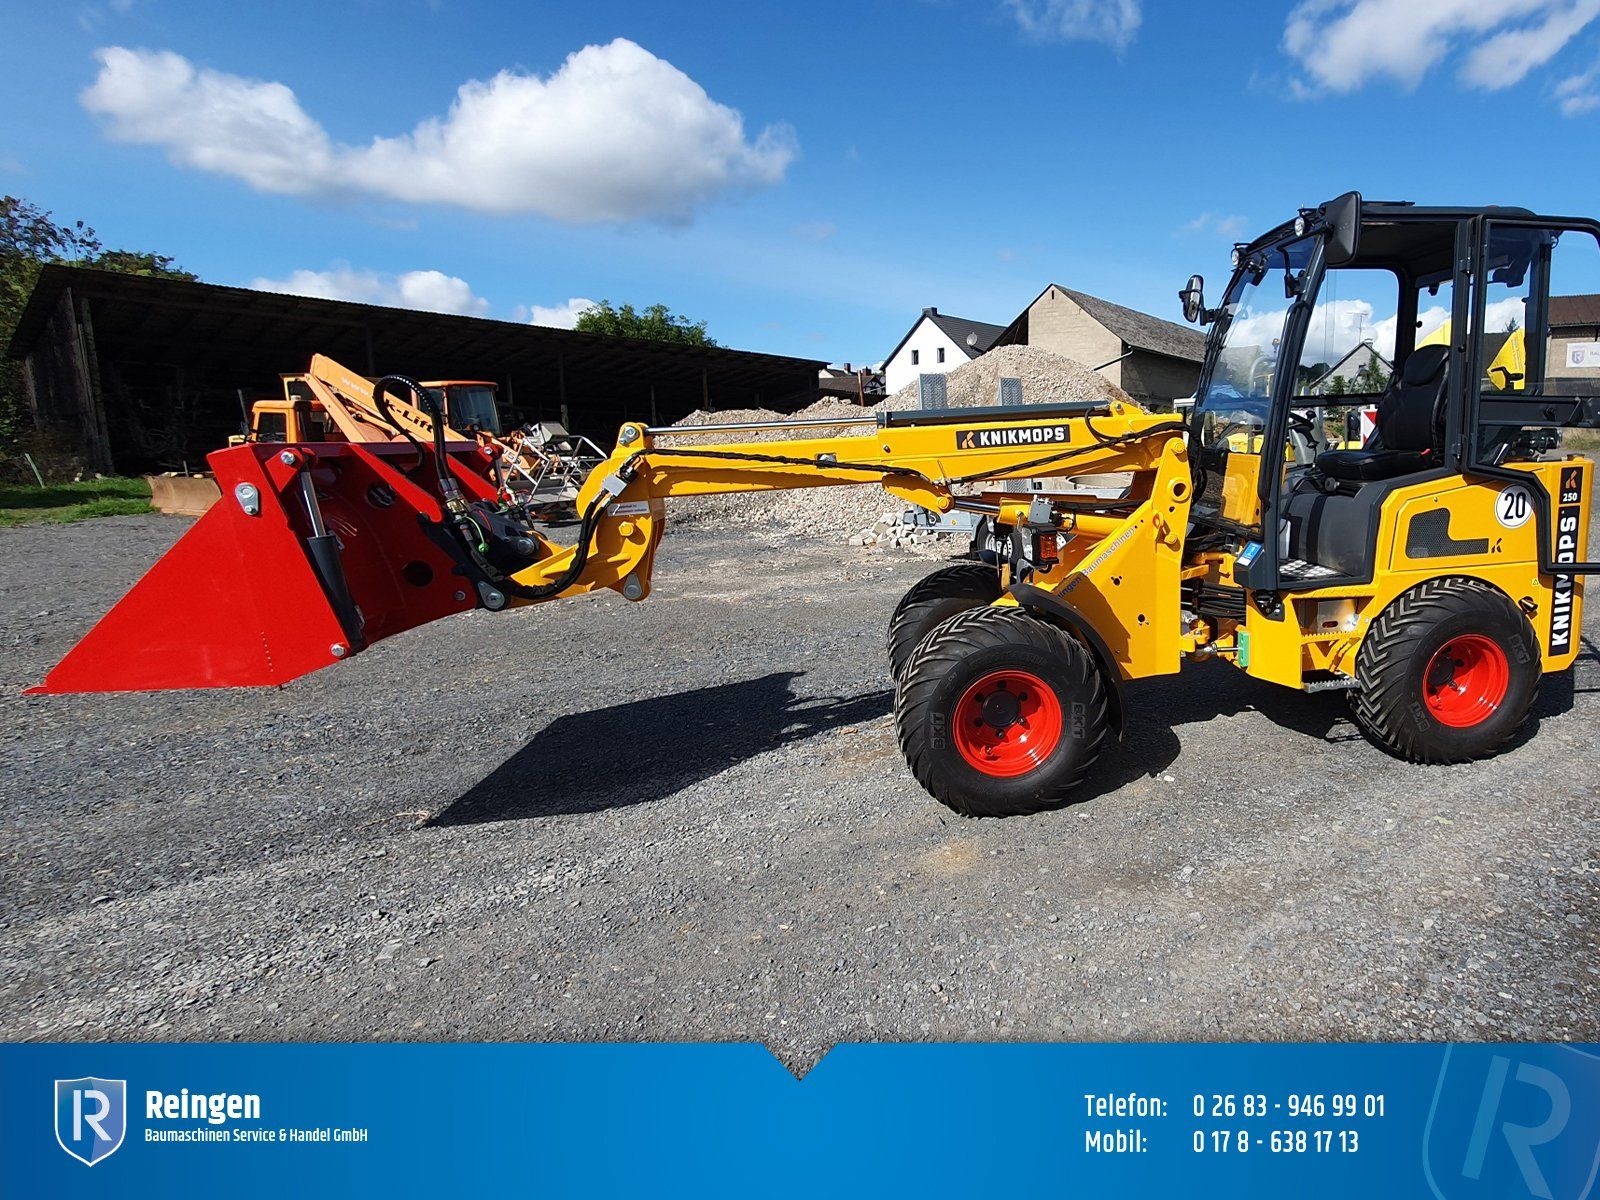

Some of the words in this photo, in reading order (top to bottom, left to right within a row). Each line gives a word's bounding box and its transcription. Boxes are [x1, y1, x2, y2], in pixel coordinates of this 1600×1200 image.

[979, 427, 1065, 446] KNIKMOPS
[1503, 491, 1527, 520] 20
[1562, 492, 1578, 502] 250
[1081, 527, 1135, 576] Baumaschinen
